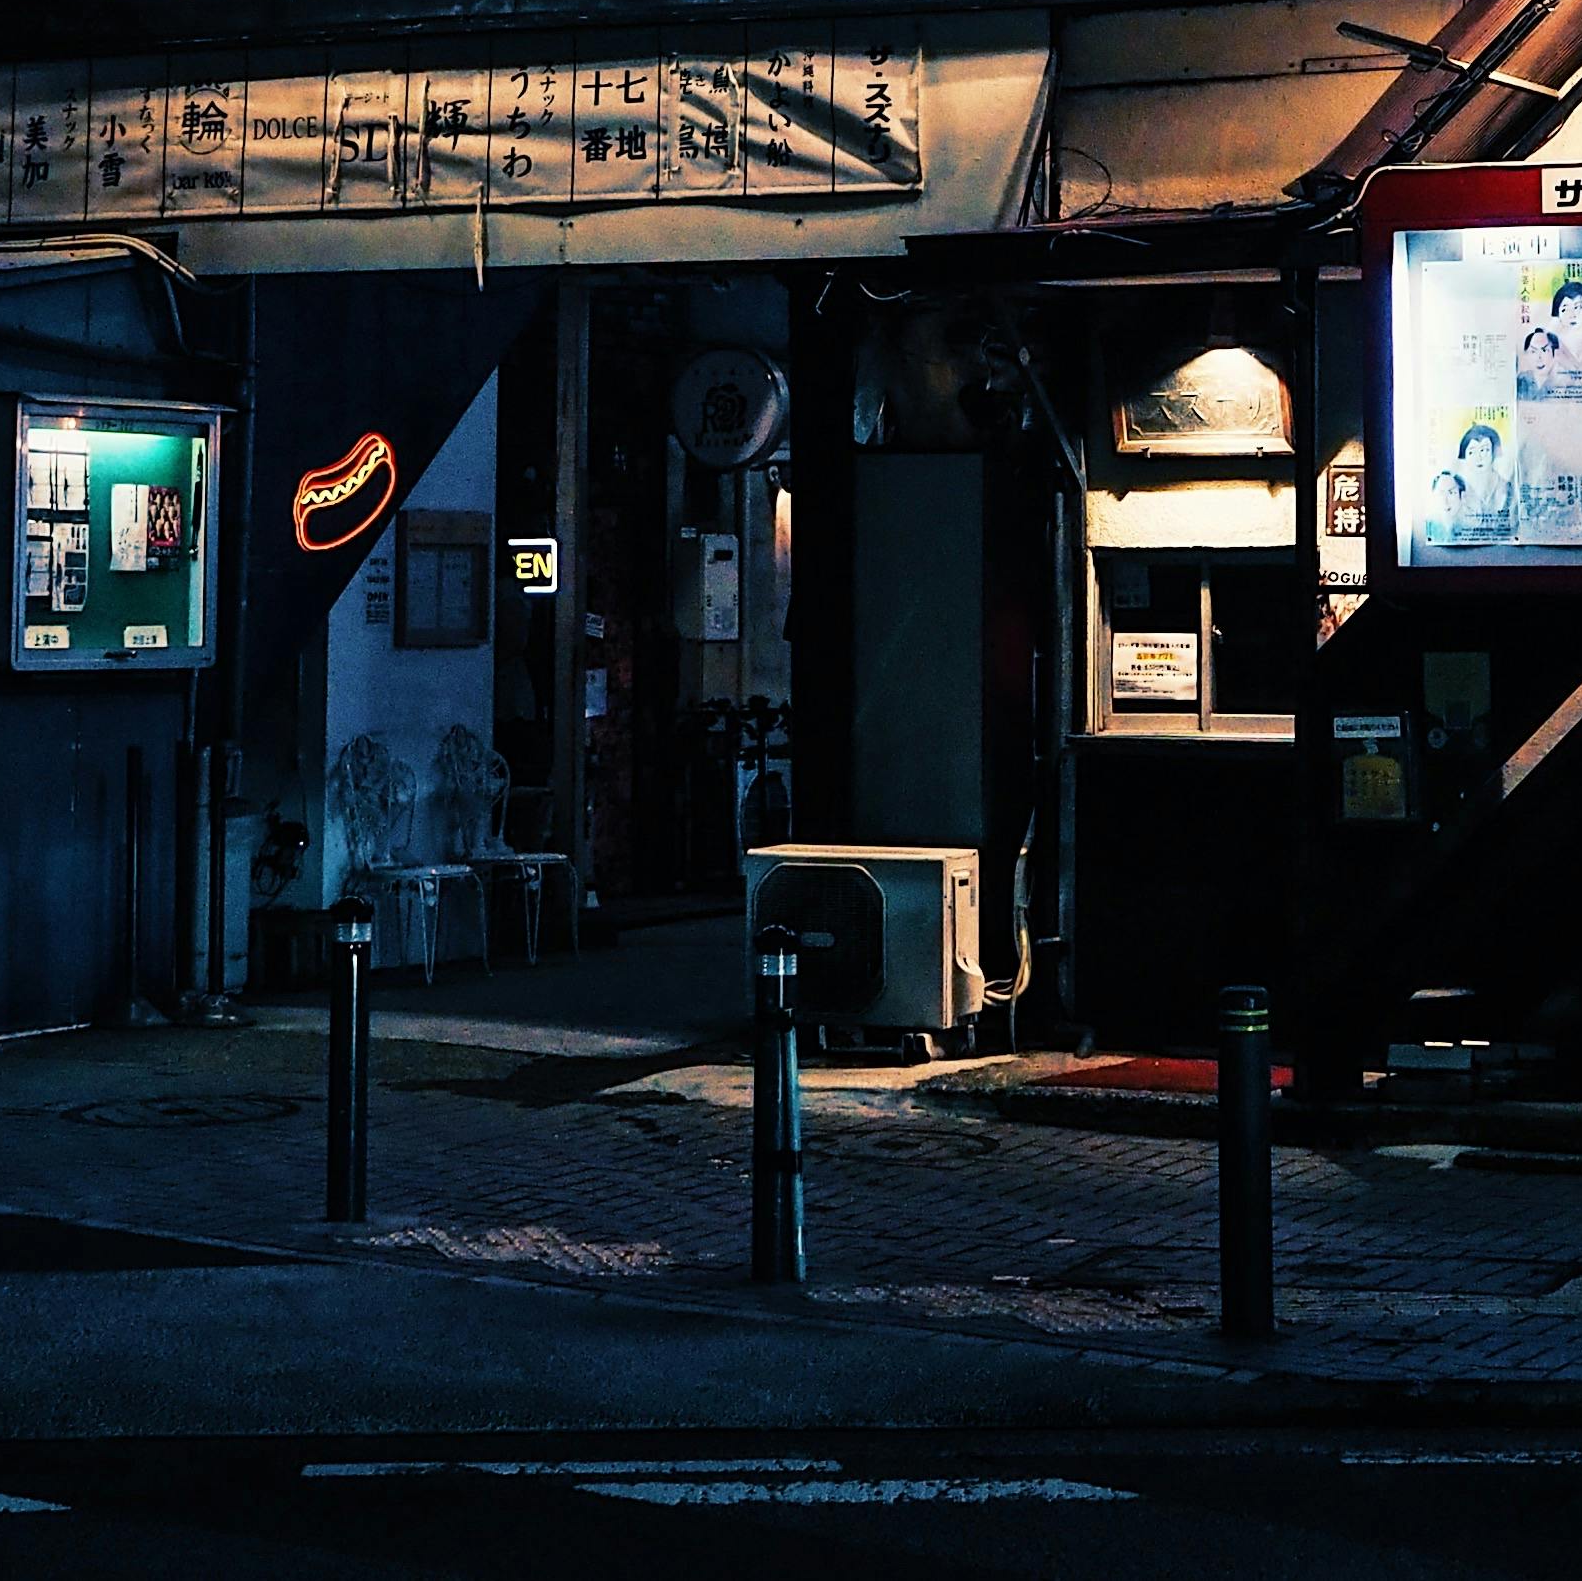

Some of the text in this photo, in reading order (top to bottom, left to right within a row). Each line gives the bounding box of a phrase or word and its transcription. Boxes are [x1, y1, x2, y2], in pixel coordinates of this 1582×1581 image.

[540, 64, 557, 126] スナック
[581, 69, 648, 106] 十七
[767, 50, 793, 167] かよい船
[864, 45, 893, 164] ザ・スズナリ
[21, 114, 50, 190] 美加
[98, 114, 127, 188] 小雪
[181, 100, 228, 144] 輪
[253, 116, 318, 141] DOLCE
[502, 66, 533, 179] うちわ
[580, 124, 648, 164] 番地
